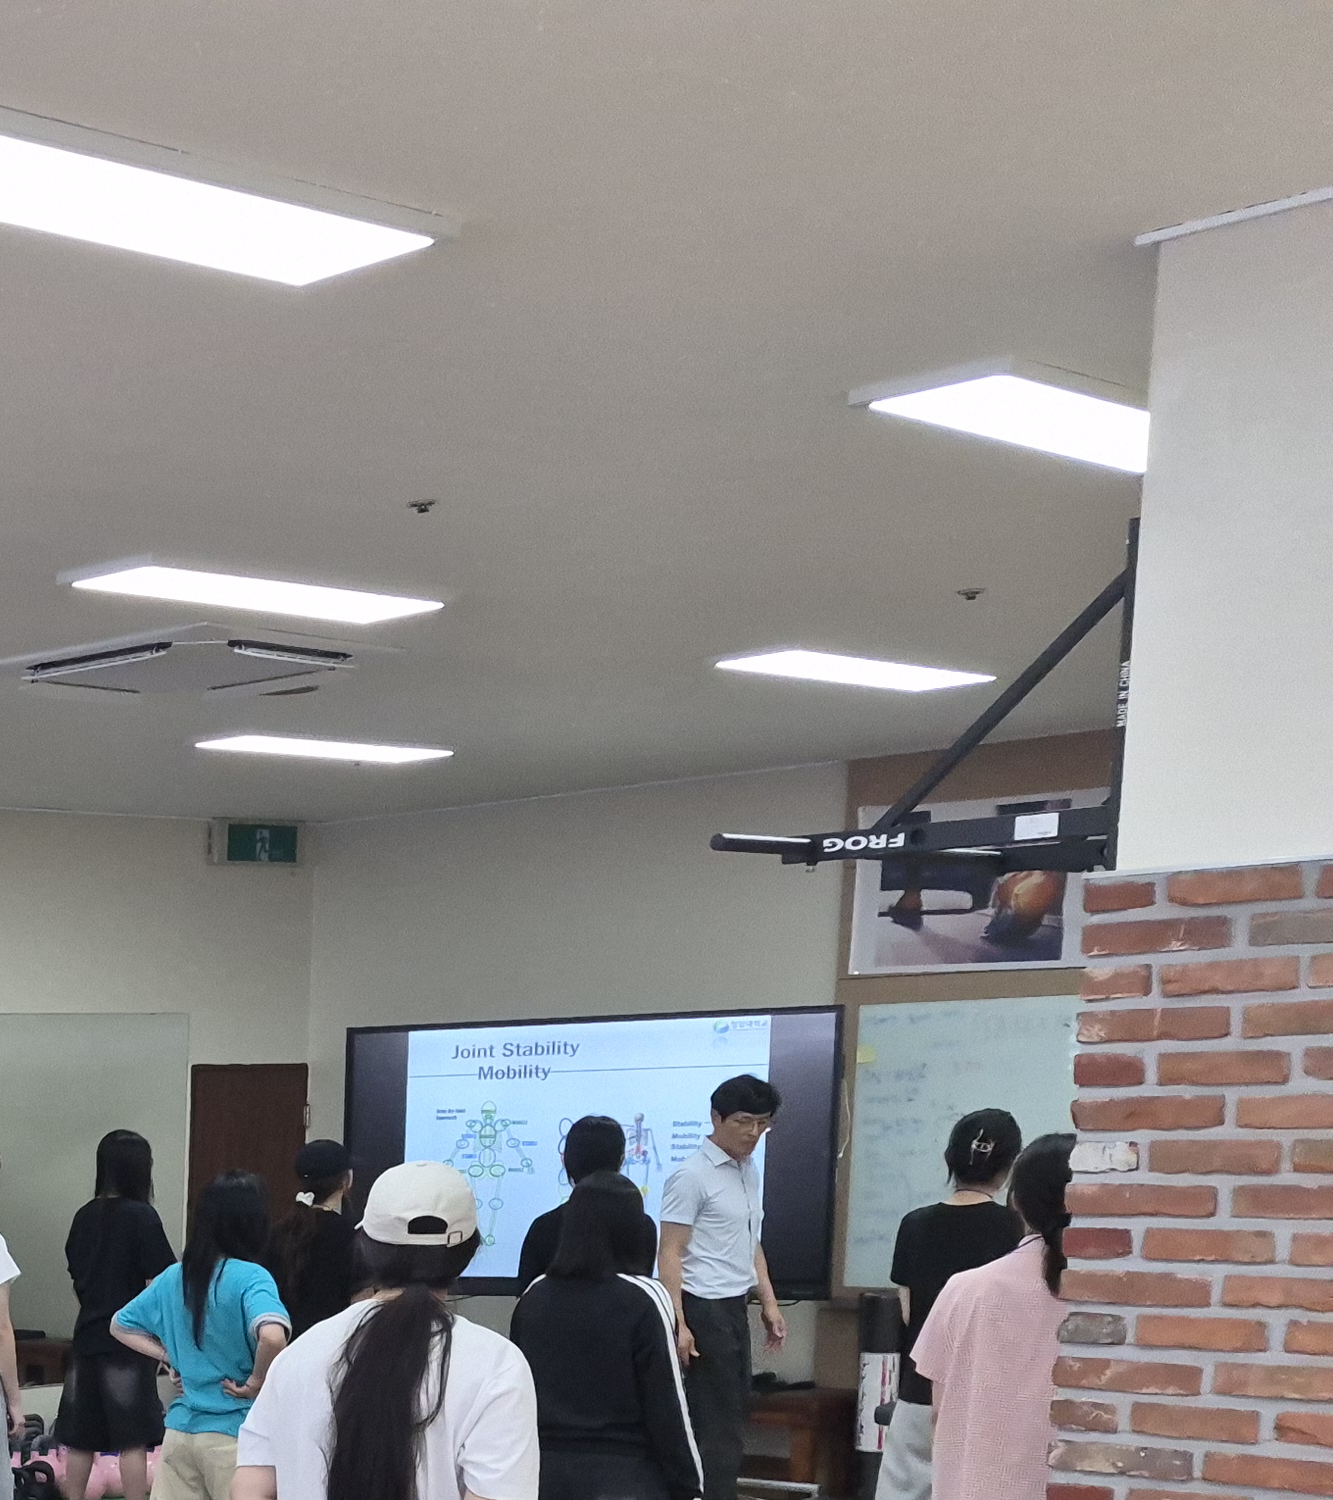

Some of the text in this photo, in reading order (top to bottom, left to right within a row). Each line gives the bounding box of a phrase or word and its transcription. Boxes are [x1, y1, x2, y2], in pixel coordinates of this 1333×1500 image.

[1116, 660, 1131, 728] MADE IN CHINA
[822, 832, 905, 853] FROG
[452, 1040, 581, 1060] Joint Stability
[477, 1064, 552, 1081] Mobility
